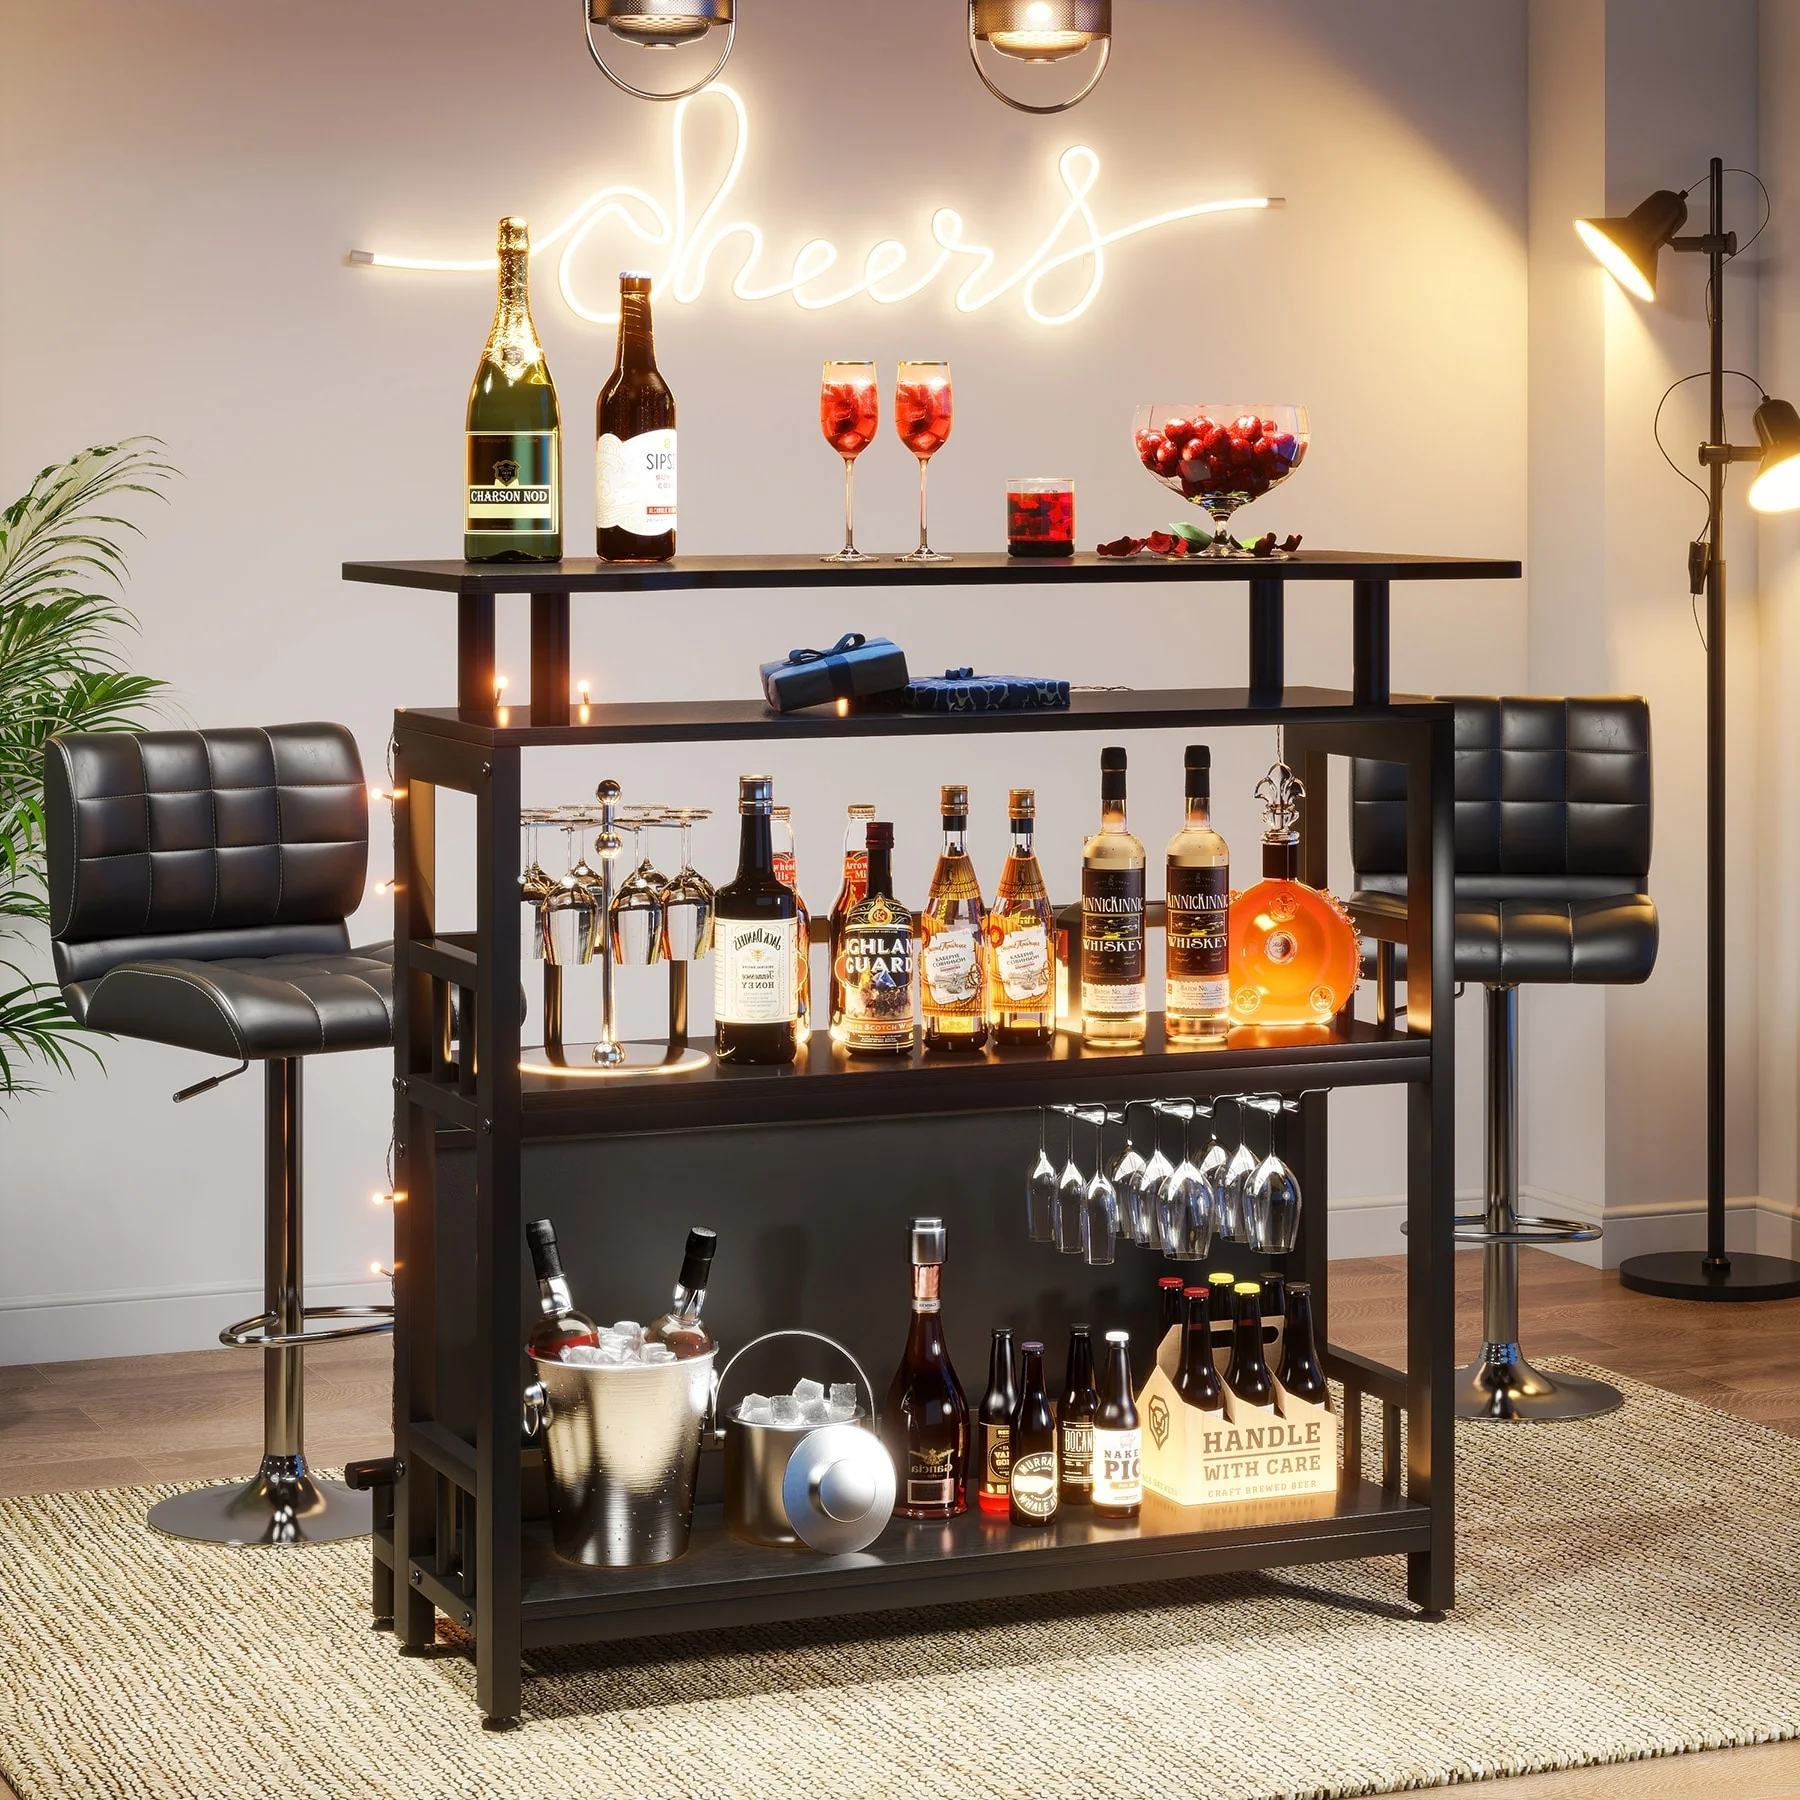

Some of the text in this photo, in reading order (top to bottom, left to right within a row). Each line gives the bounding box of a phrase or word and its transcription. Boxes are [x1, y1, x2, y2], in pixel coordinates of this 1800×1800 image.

[646, 453, 675, 470] SIPS
[470, 490, 548, 502] CHARSON NOD
[1083, 939, 1144, 953] WHISKEY
[1167, 935, 1228, 949] WHISKEY
[845, 957, 913, 974] GUARD
[864, 1023, 897, 1031] SCOTCH
[1203, 1422, 1321, 1454] HANDLE
[1203, 1455, 1321, 1482] WITH CARE
[1208, 1480, 1317, 1498] CRAFT BREWED BEER
